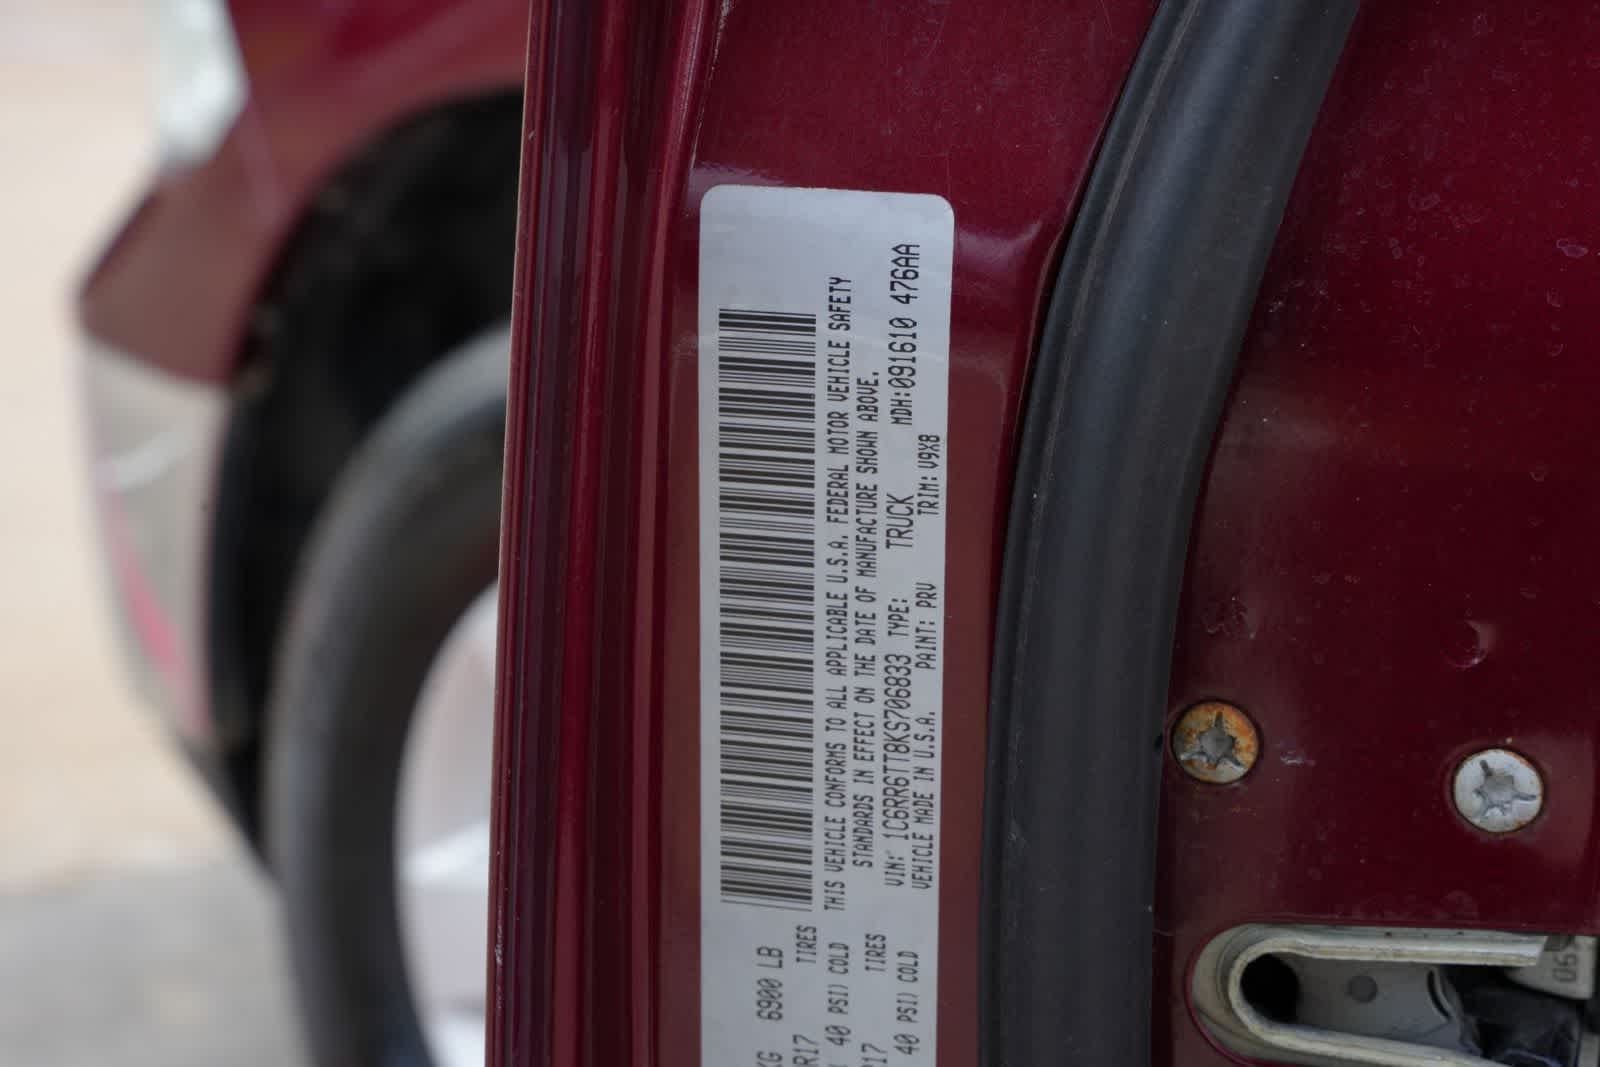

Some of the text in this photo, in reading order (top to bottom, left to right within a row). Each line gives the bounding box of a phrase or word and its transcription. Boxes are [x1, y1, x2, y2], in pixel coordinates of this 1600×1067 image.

[890, 244, 920, 304] 476AA
[886, 493, 914, 549] TRUCK
[824, 277, 851, 910] THIS VEHICLE CONFORMS TO ALL APPLICABLE U.S.A. FEDERAL MOTOR VEHICLE SAFETY
[852, 372, 879, 867] STANDARDS IN EFFECT ON THE DATE OF MANUFACTURE SHOWN ABOVE.
[888, 599, 909, 636] TYPE:
[912, 435, 940, 889] VEHICLE MADE IN U.S.A. PAINT: PRV TRIM: V9X8
[882, 654, 911, 840] 1C6RR6TT8KS706833
[885, 856, 905, 886] VIN:
[757, 947, 783, 968] LB
[796, 925, 816, 962] TIRES
[828, 943, 849, 974] COLD
[865, 934, 886, 971] TIRES
[757, 978, 783, 1020] 6900
[828, 985, 848, 1014] PSI)
[894, 951, 920, 1055] 40 PSI) COLD
[825, 1026, 851, 1046] 40
